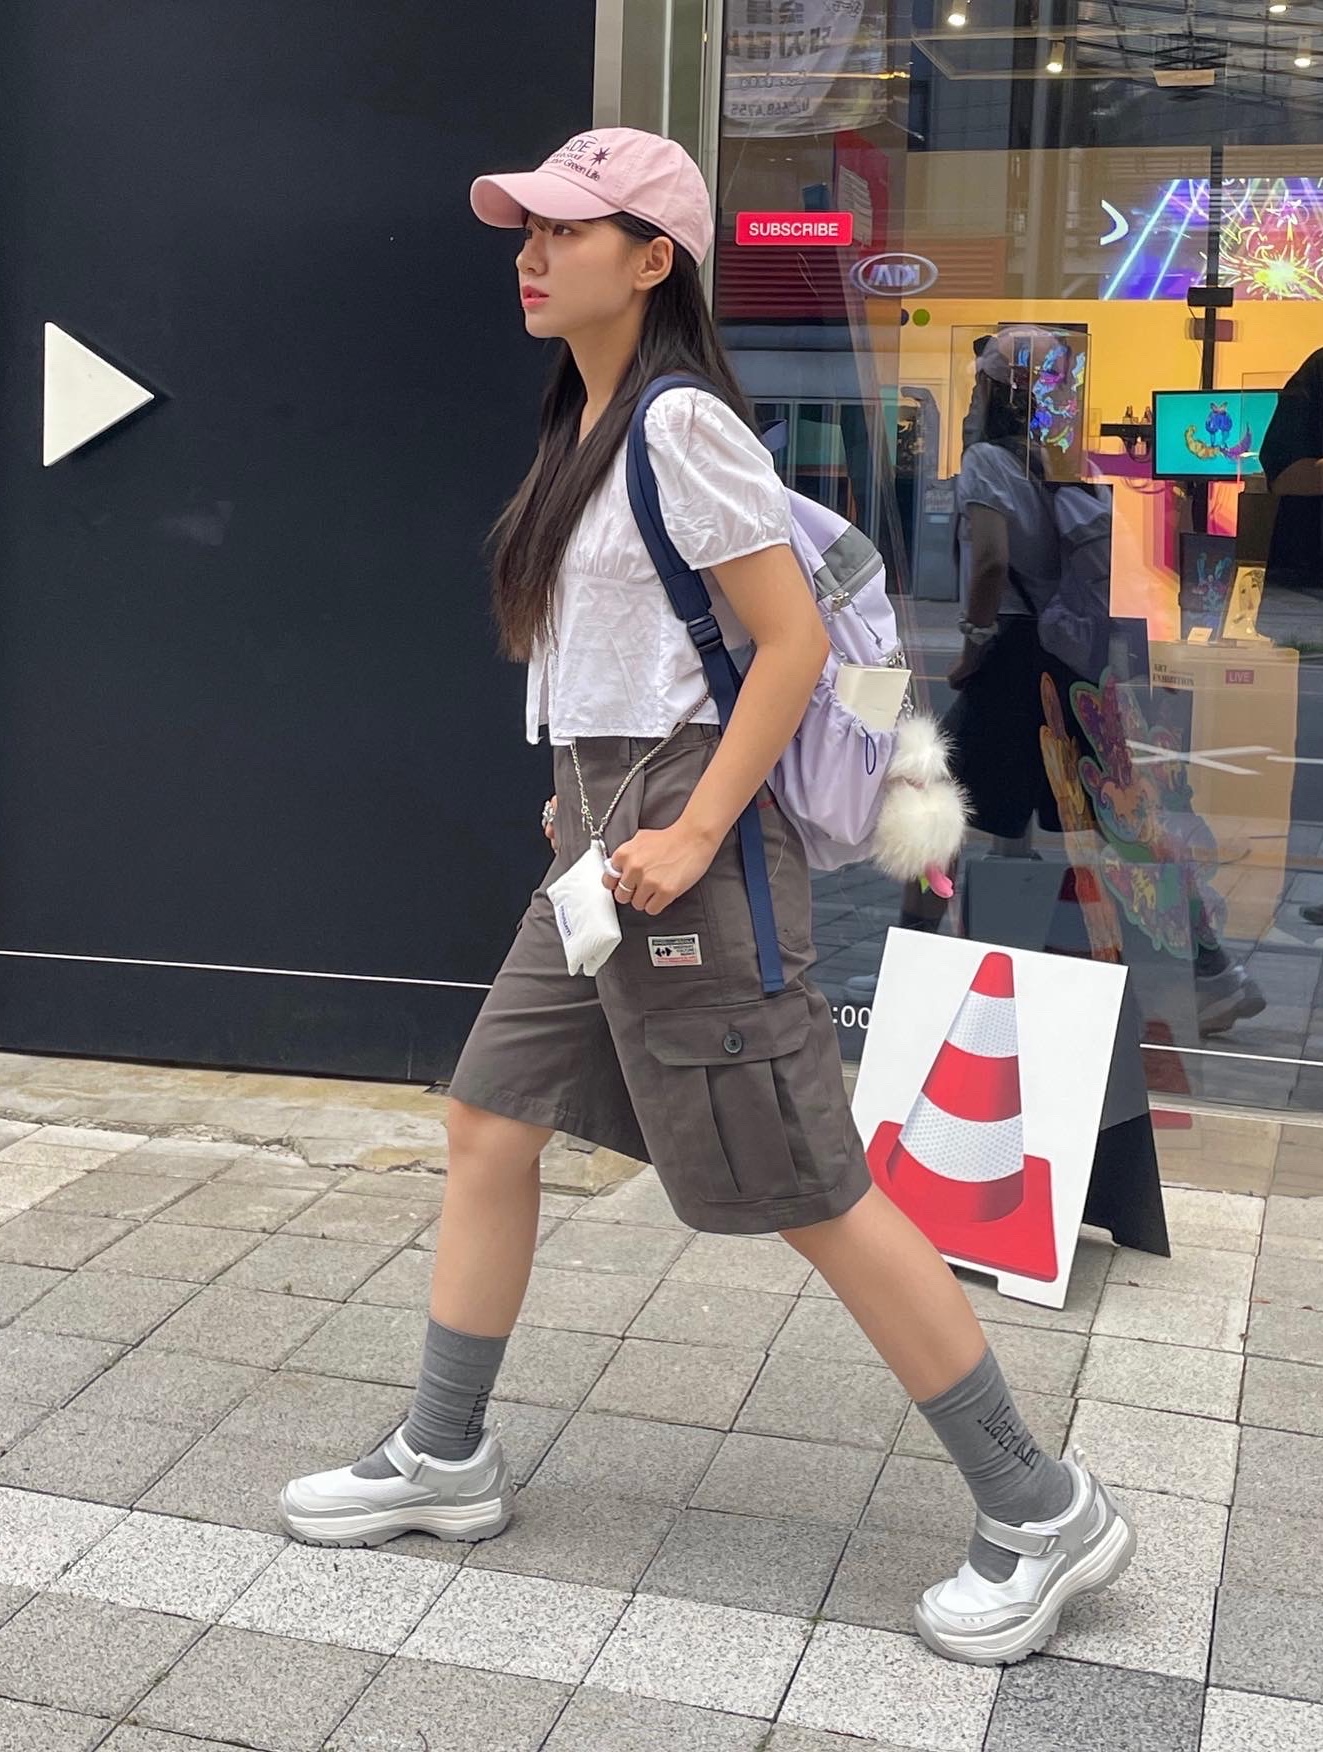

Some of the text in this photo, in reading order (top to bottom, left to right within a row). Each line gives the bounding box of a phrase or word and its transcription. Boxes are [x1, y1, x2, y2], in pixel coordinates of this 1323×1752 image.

[563, 159, 587, 175] Green
[748, 222, 839, 237] SUBSCRIBE
[1229, 671, 1251, 683] LIVE
